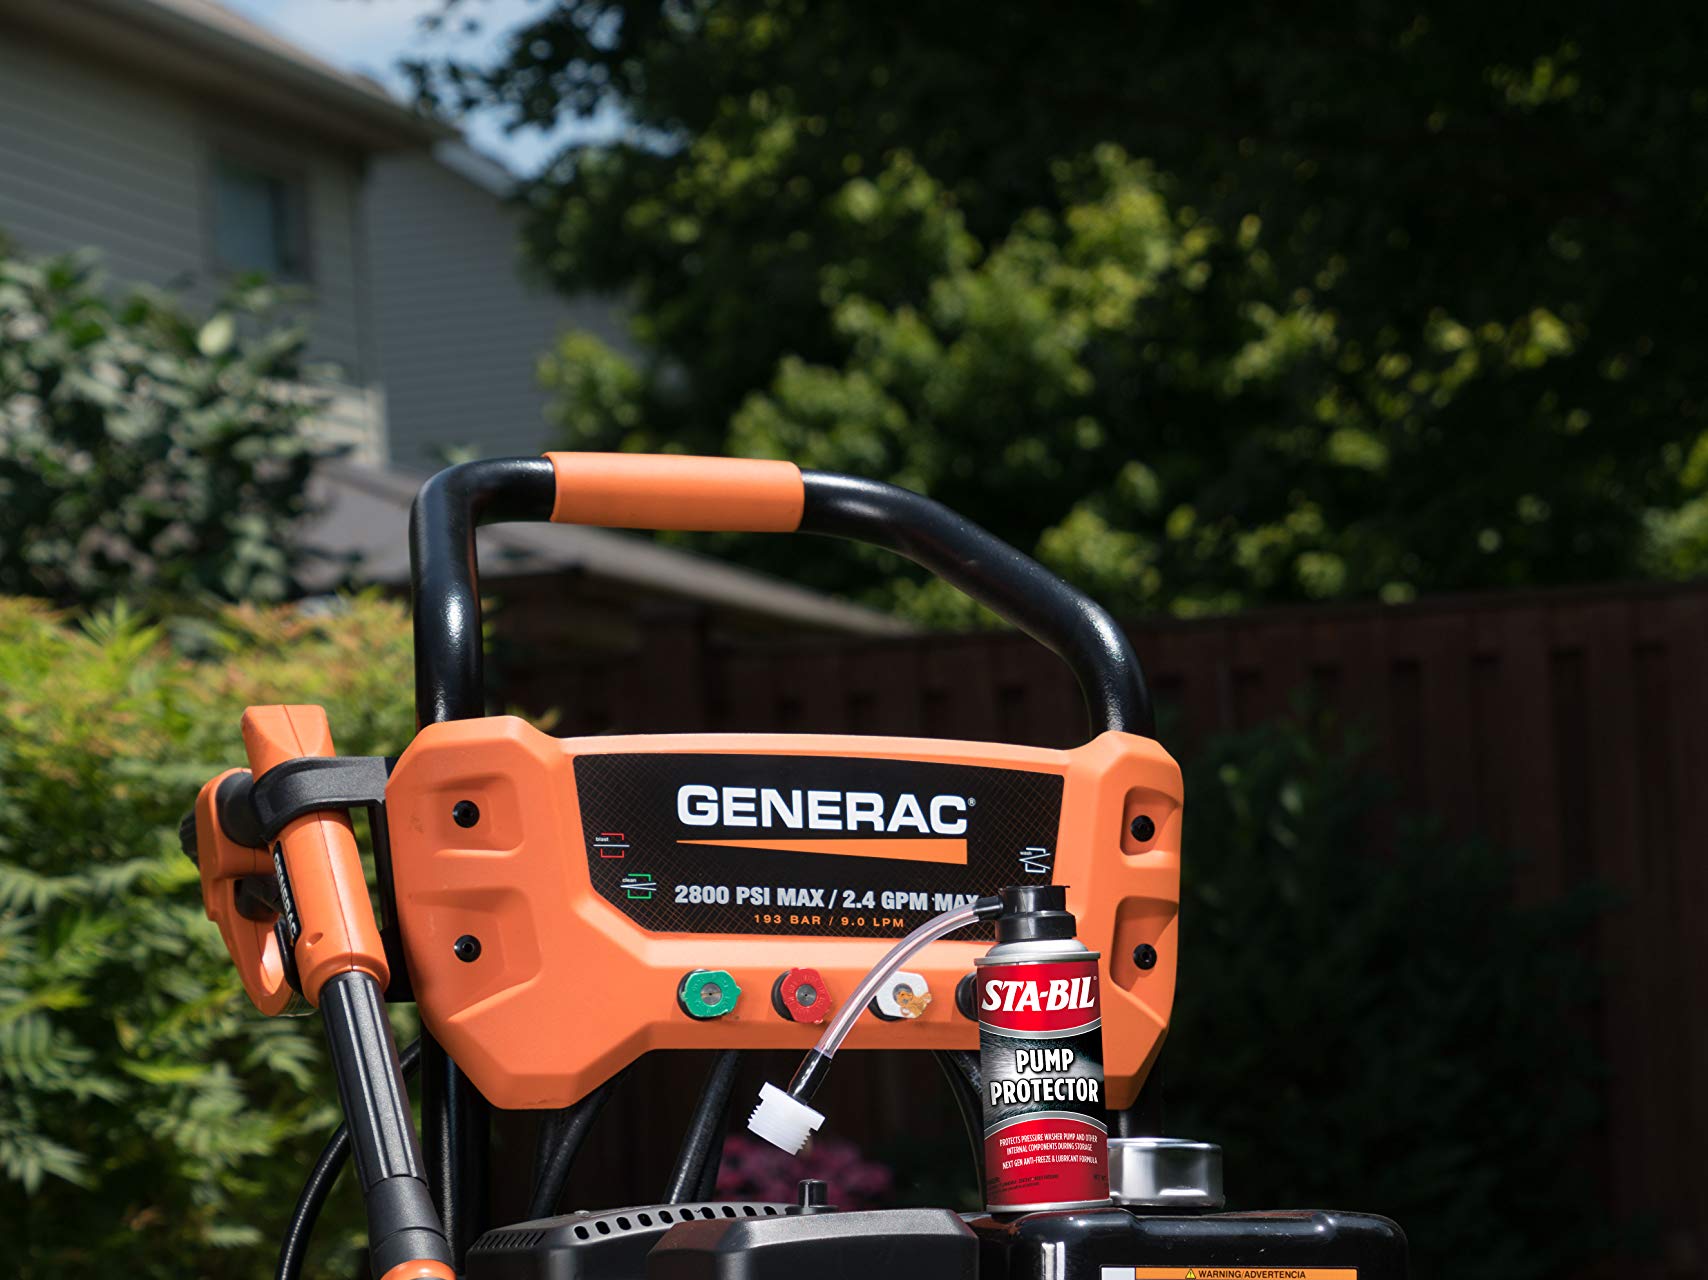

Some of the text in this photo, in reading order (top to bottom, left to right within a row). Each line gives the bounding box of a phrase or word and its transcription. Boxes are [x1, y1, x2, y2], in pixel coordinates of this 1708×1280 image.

[677, 784, 968, 835] GENERAC
[675, 885, 729, 905] 2800
[736, 887, 770, 906] PSI
[777, 888, 824, 908] MAX
[829, 889, 839, 910] /
[843, 890, 875, 910] 2.4
[881, 891, 928, 911] GPM
[754, 914, 782, 925] 193
[790, 914, 822, 926] BAR
[841, 916, 865, 927] 9.0
[872, 917, 904, 928] LPM
[981, 976, 1095, 1012] STA-BIL
[1015, 1048, 1074, 1073] PUMP
[989, 1077, 1099, 1106] PROTECTOR
[1000, 1136, 1020, 1146] PROTECTS
[1021, 1134, 1044, 1142] PRESSURE
[1086, 1134, 1098, 1142] OTHER
[1006, 1145, 1028, 1156] INTERNAL
[1028, 1143, 1058, 1152] COMPONENTS
[1075, 1142, 1092, 1151] STORAGE
[1002, 1160, 1013, 1170] NEXT
[1024, 1155, 1050, 1165] ANTI-FREEZE
[1079, 1156, 1098, 1164] FORMULA
[1198, 1270, 1306, 1279] WARNING/ADVERTENCIA
